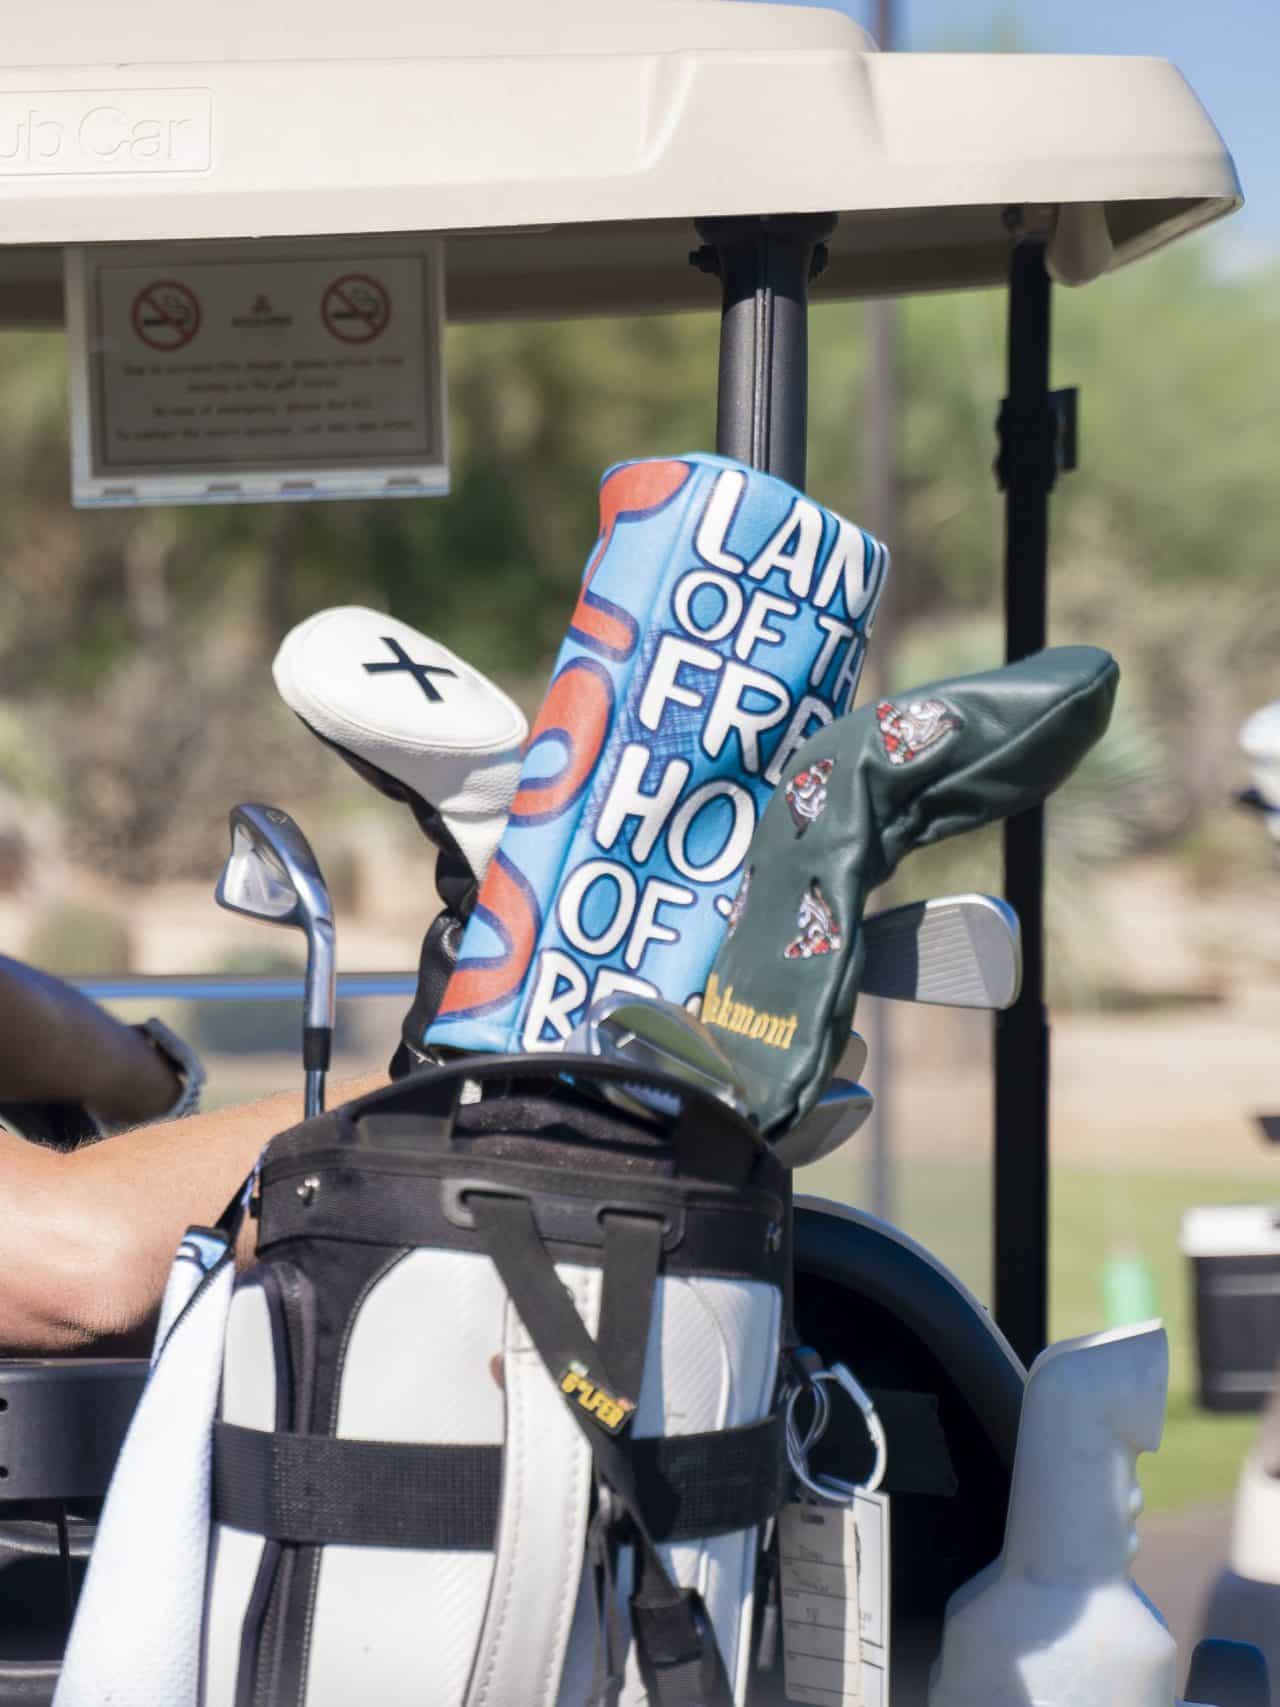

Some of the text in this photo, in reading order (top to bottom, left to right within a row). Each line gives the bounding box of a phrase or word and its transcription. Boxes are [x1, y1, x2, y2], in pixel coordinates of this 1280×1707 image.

[77, 105, 193, 158] Car
[694, 468, 890, 638] LAN
[673, 569, 797, 661] OF
[558, 859, 695, 970] OF
